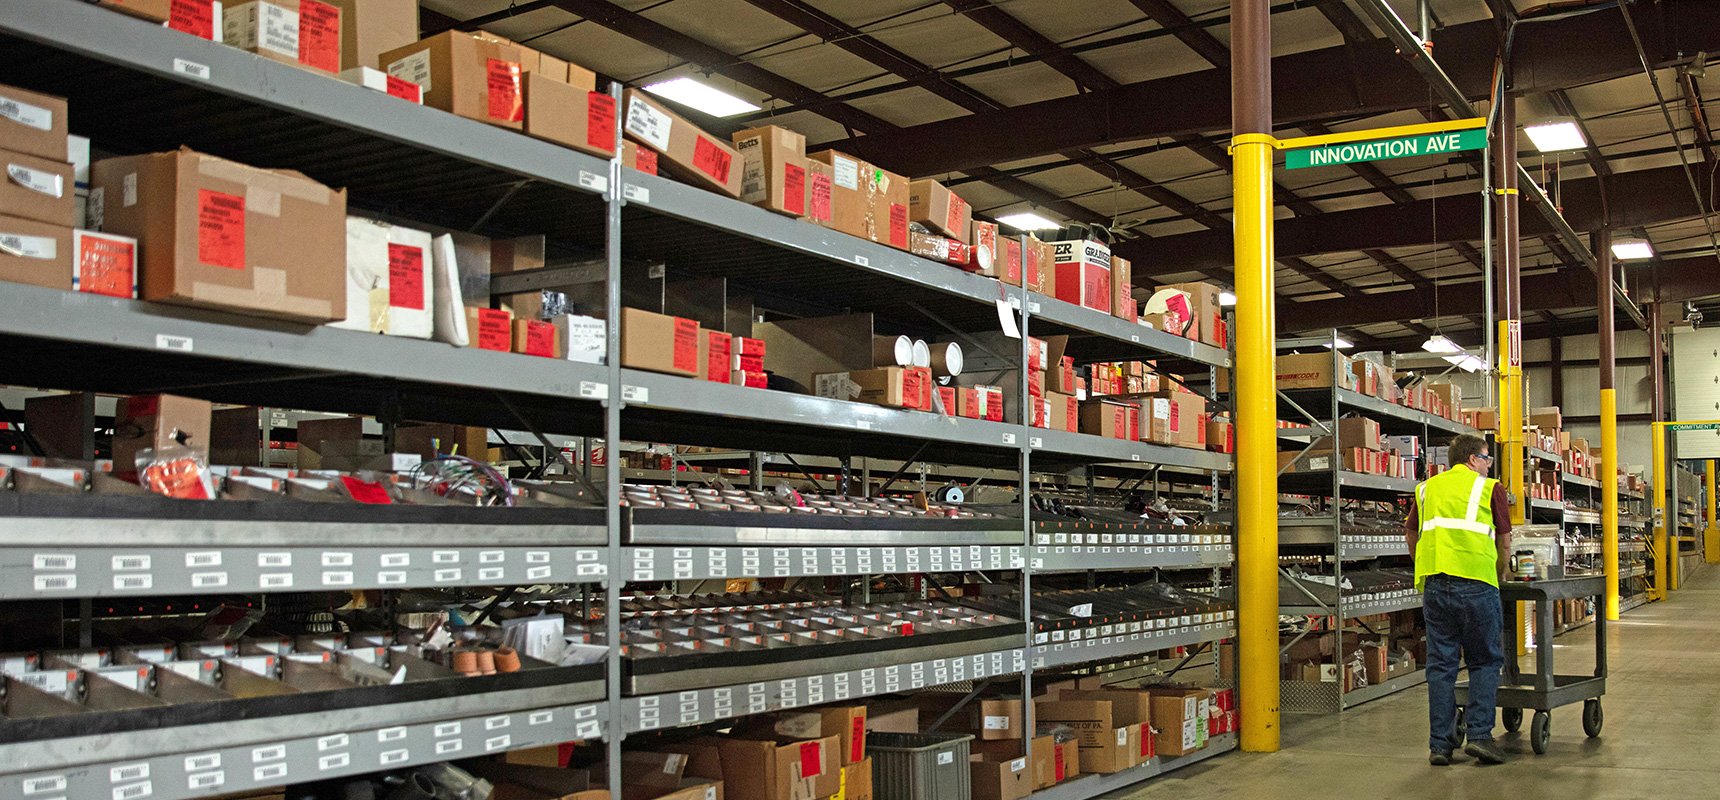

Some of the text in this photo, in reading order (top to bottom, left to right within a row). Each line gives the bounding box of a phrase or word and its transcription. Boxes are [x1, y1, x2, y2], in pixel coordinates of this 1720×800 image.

[738, 138, 759, 150] Betts
[1310, 133, 1461, 165] INNOVATION AVE
[1055, 243, 1073, 255] ER
